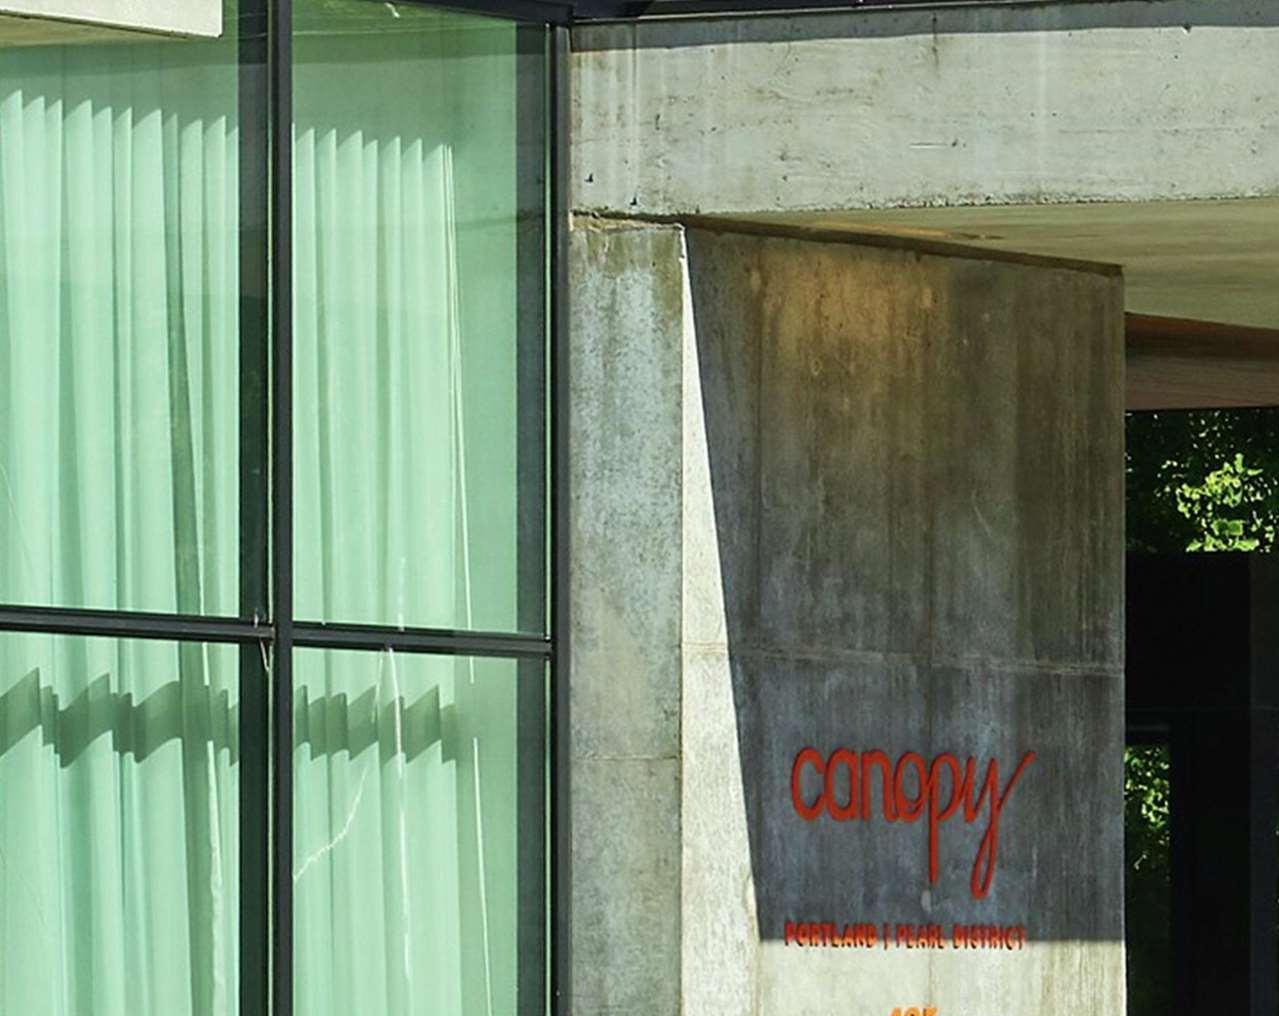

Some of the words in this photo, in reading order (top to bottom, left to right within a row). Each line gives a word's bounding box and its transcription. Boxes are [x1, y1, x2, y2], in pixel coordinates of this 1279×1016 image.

[791, 747, 1037, 900] canopy
[784, 921, 877, 948] PORTLAND
[895, 923, 944, 949] PEARL
[953, 923, 1026, 950] DISTRICT
